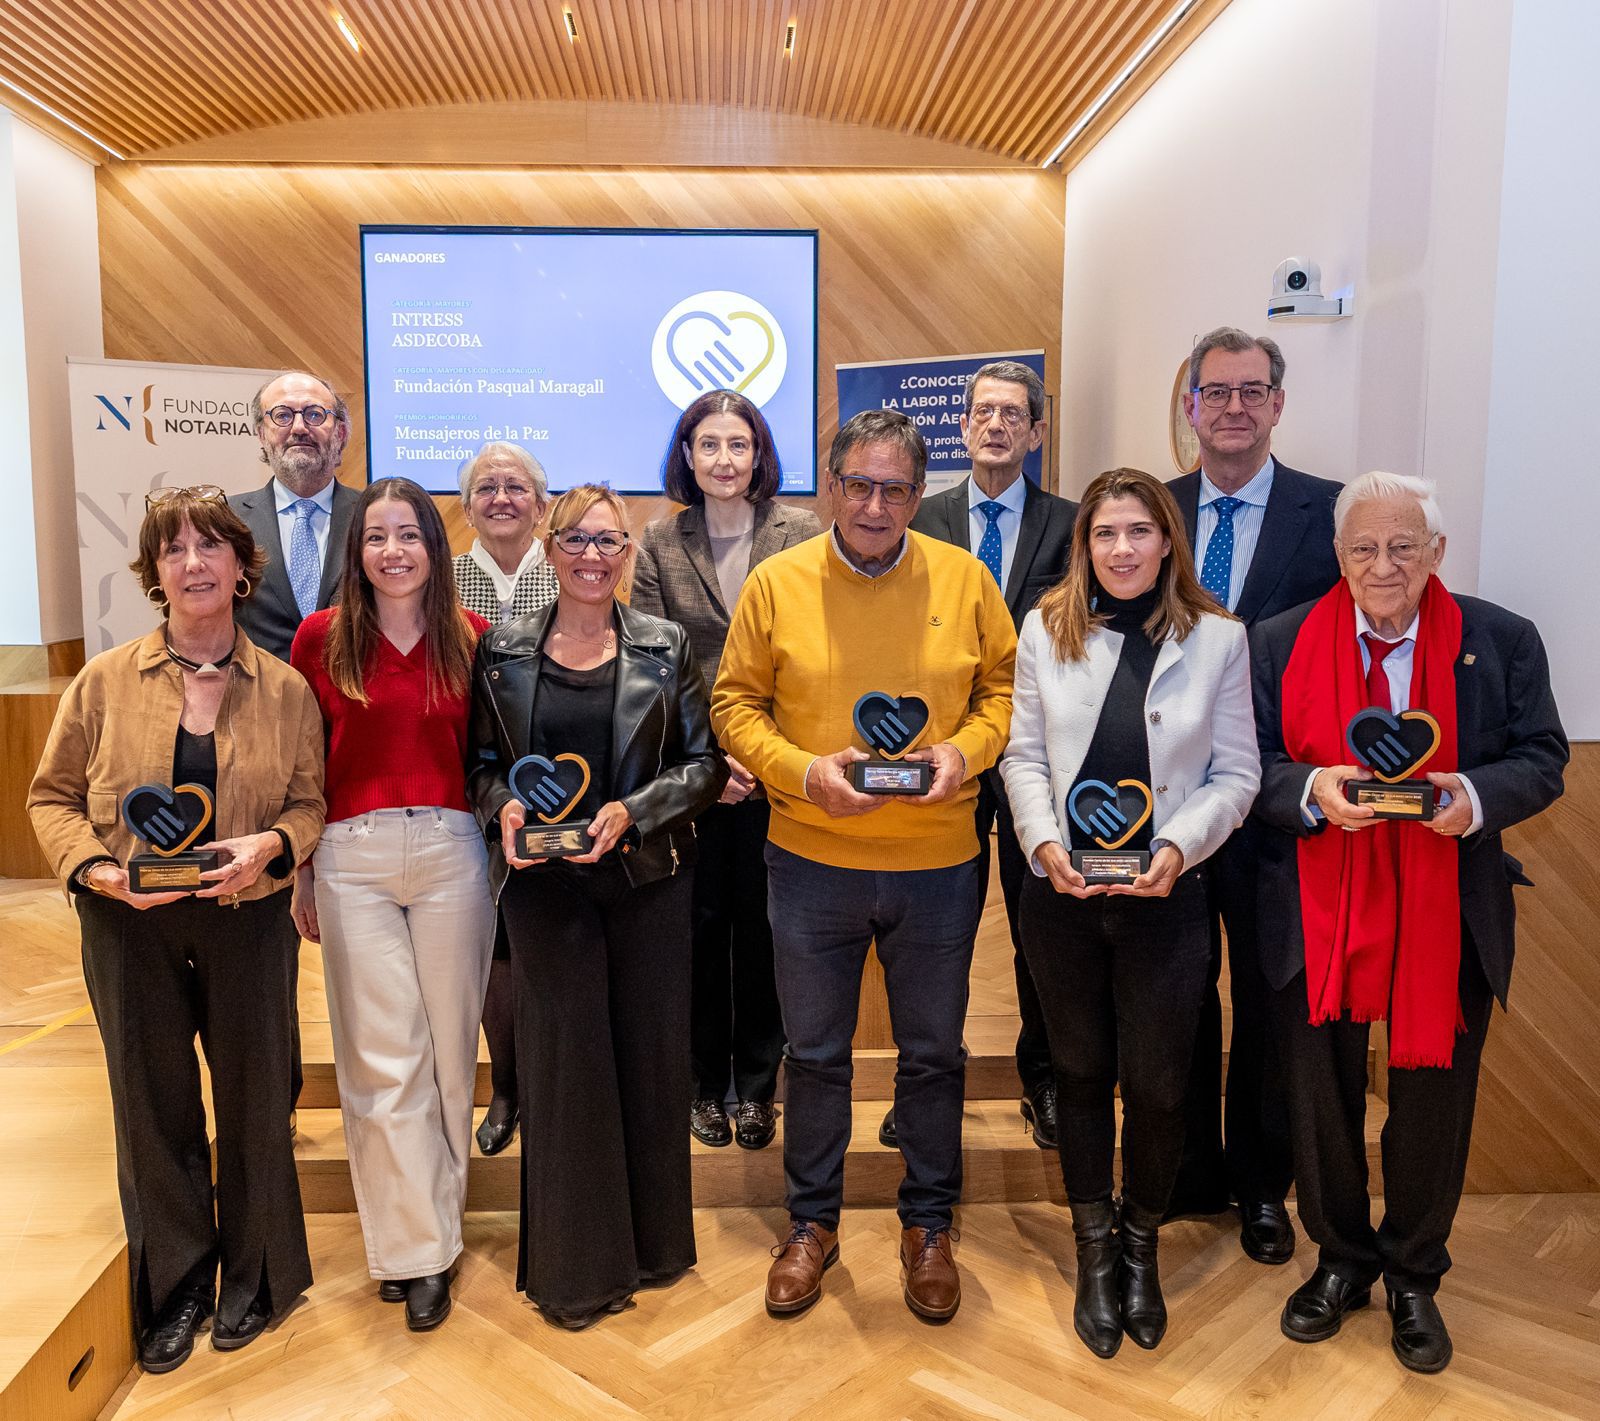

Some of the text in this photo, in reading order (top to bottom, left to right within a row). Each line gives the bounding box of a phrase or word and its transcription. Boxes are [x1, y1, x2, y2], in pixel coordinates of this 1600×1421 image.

[374, 252, 446, 263] GANADORES
[391, 312, 464, 327] INTRESS
[391, 333, 483, 348] ASDECOBA
[473, 367, 489, 375] CON
[393, 378, 605, 397] Fundación Pasqual Maragall
[163, 398, 254, 417] FUNDACI
[881, 394, 966, 409] LA LABOR D
[909, 412, 961, 426] IÓN AE
[394, 426, 549, 443] Mensajeros de la Paz
[395, 445, 474, 461] Fundación
[930, 450, 949, 460] con
